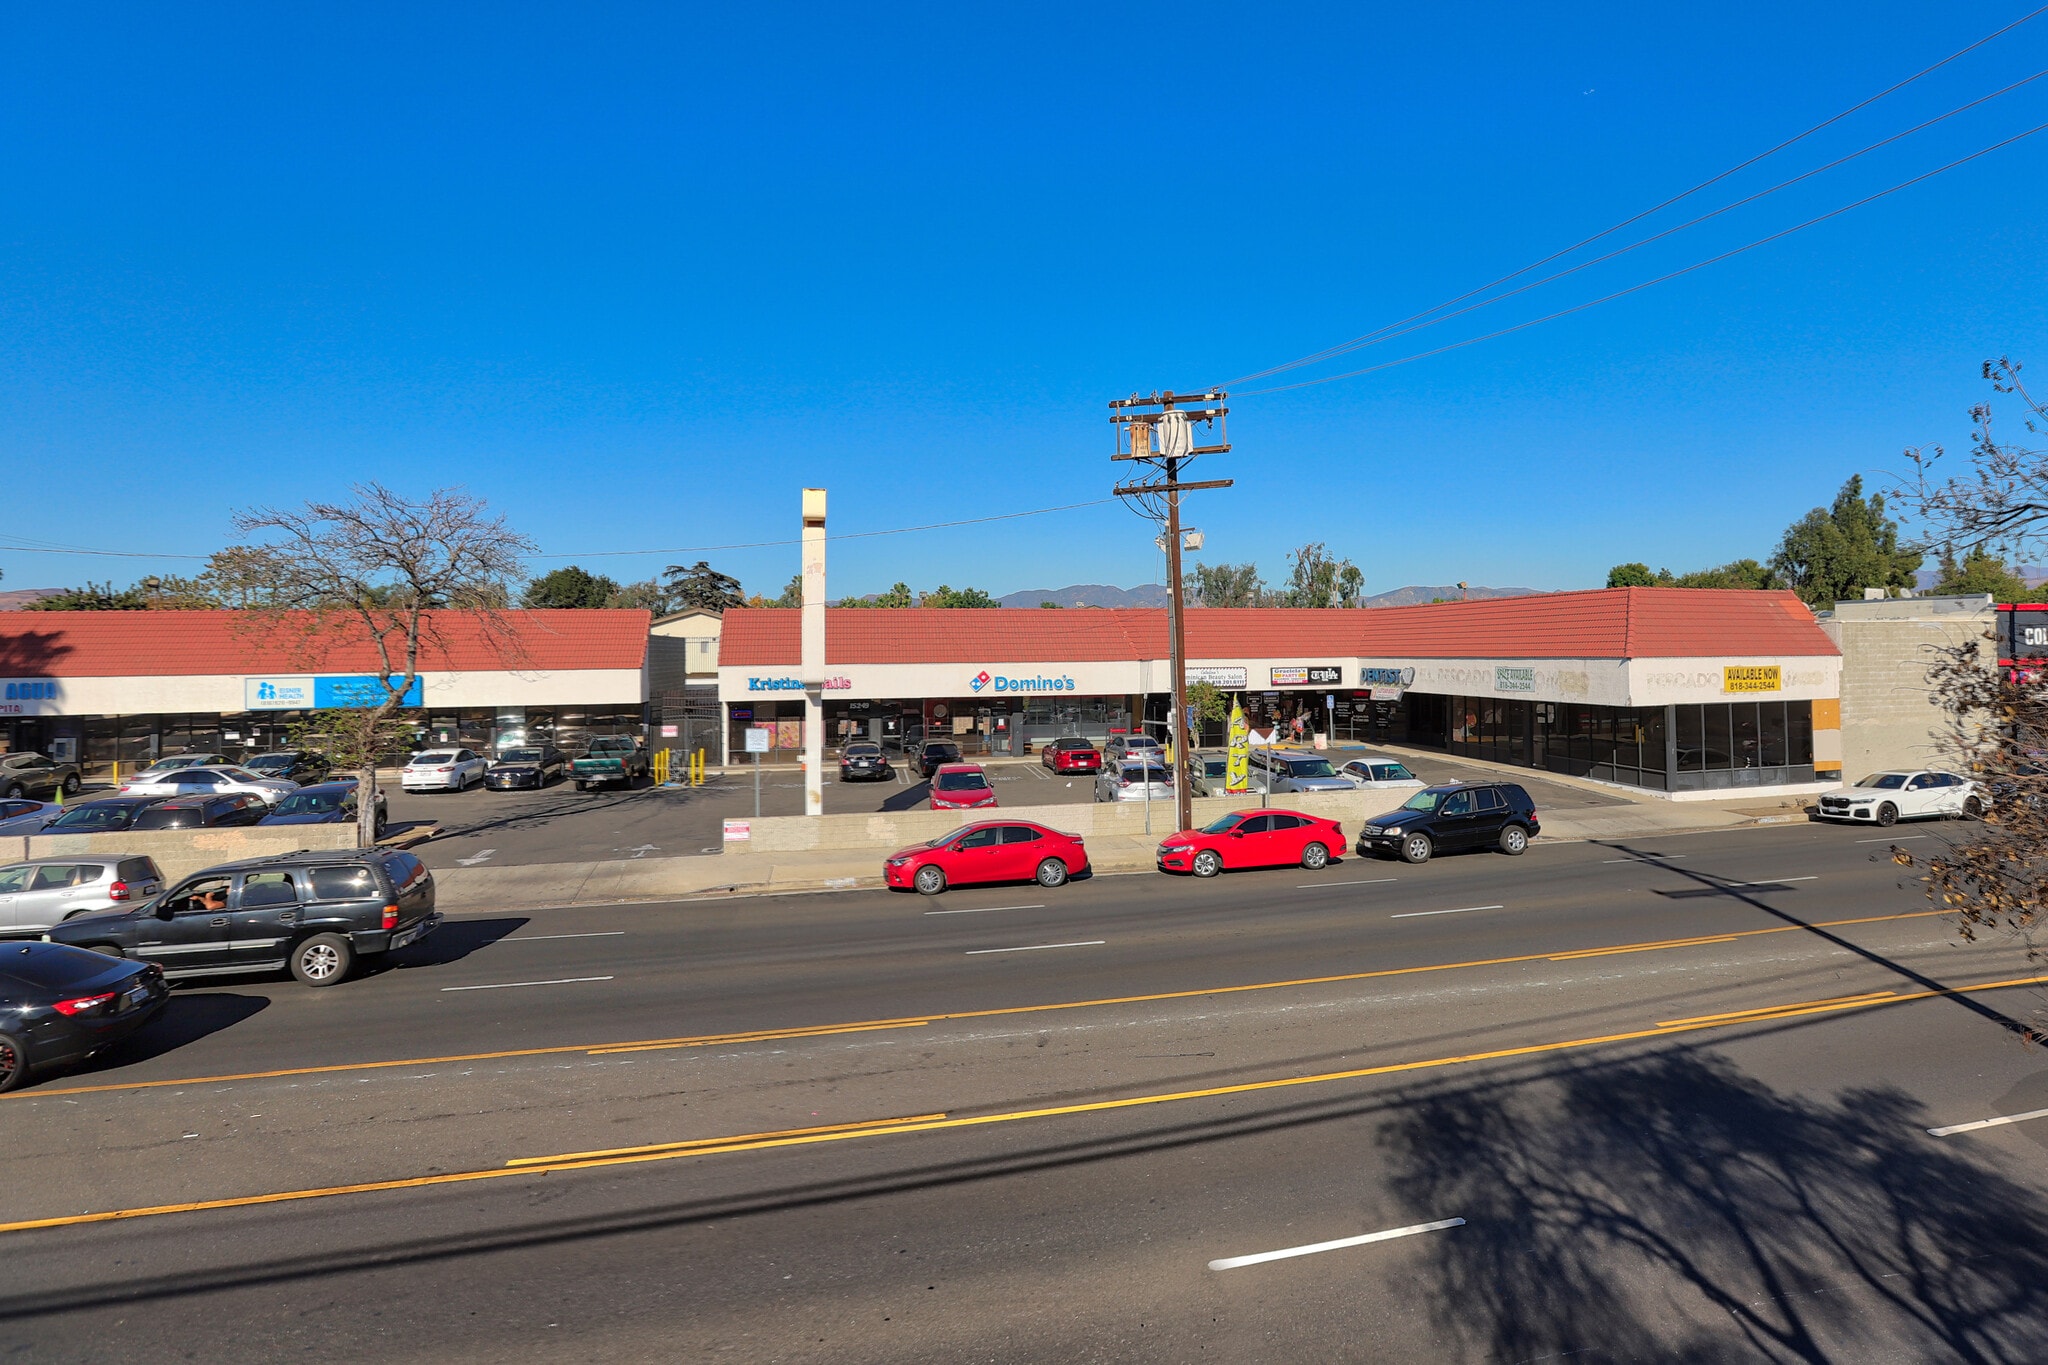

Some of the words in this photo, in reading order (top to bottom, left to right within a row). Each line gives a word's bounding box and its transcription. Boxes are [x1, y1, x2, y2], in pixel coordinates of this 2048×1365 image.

[2025, 628, 2048, 645] COL
[1360, 668, 1401, 684] DENTIST
[1510, 669, 1533, 680] AVAILABLE
[1727, 669, 1762, 680] AVAILABLE
[1763, 668, 1778, 679] NOW
[822, 677, 851, 690] ails
[994, 674, 1076, 692] Domino's
[1730, 682, 1775, 690] 818-344-2544
[5, 682, 57, 700] AGUA
